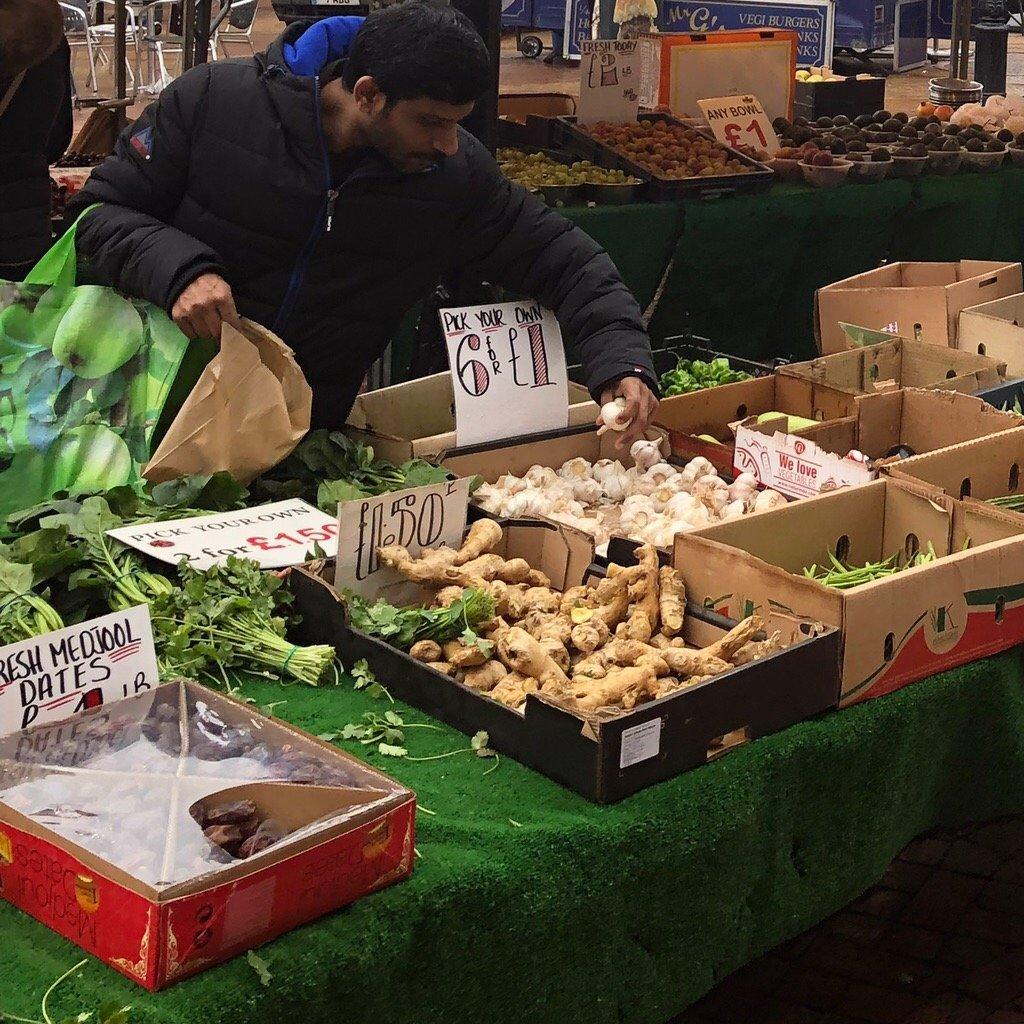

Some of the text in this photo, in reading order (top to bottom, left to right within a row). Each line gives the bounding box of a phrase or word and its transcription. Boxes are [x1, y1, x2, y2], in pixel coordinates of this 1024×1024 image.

[666, 6, 691, 26] Mr
[738, 13, 821, 29] VEGI BURGERS
[583, 41, 611, 53] FRESH
[707, 104, 763, 121] ANY BOWL
[724, 119, 768, 152] £1
[443, 305, 544, 332] PICK YOUR OWN
[456, 333, 490, 397] 6
[508, 323, 557, 389] £1
[778, 468, 817, 488] VEGETABLES
[779, 453, 818, 479] We love
[129, 505, 311, 544] PICK YOUR OWN
[202, 543, 248, 561] for
[0, 618, 142, 684] RESH MEDJOOL
[19, 657, 111, 707] DATES
